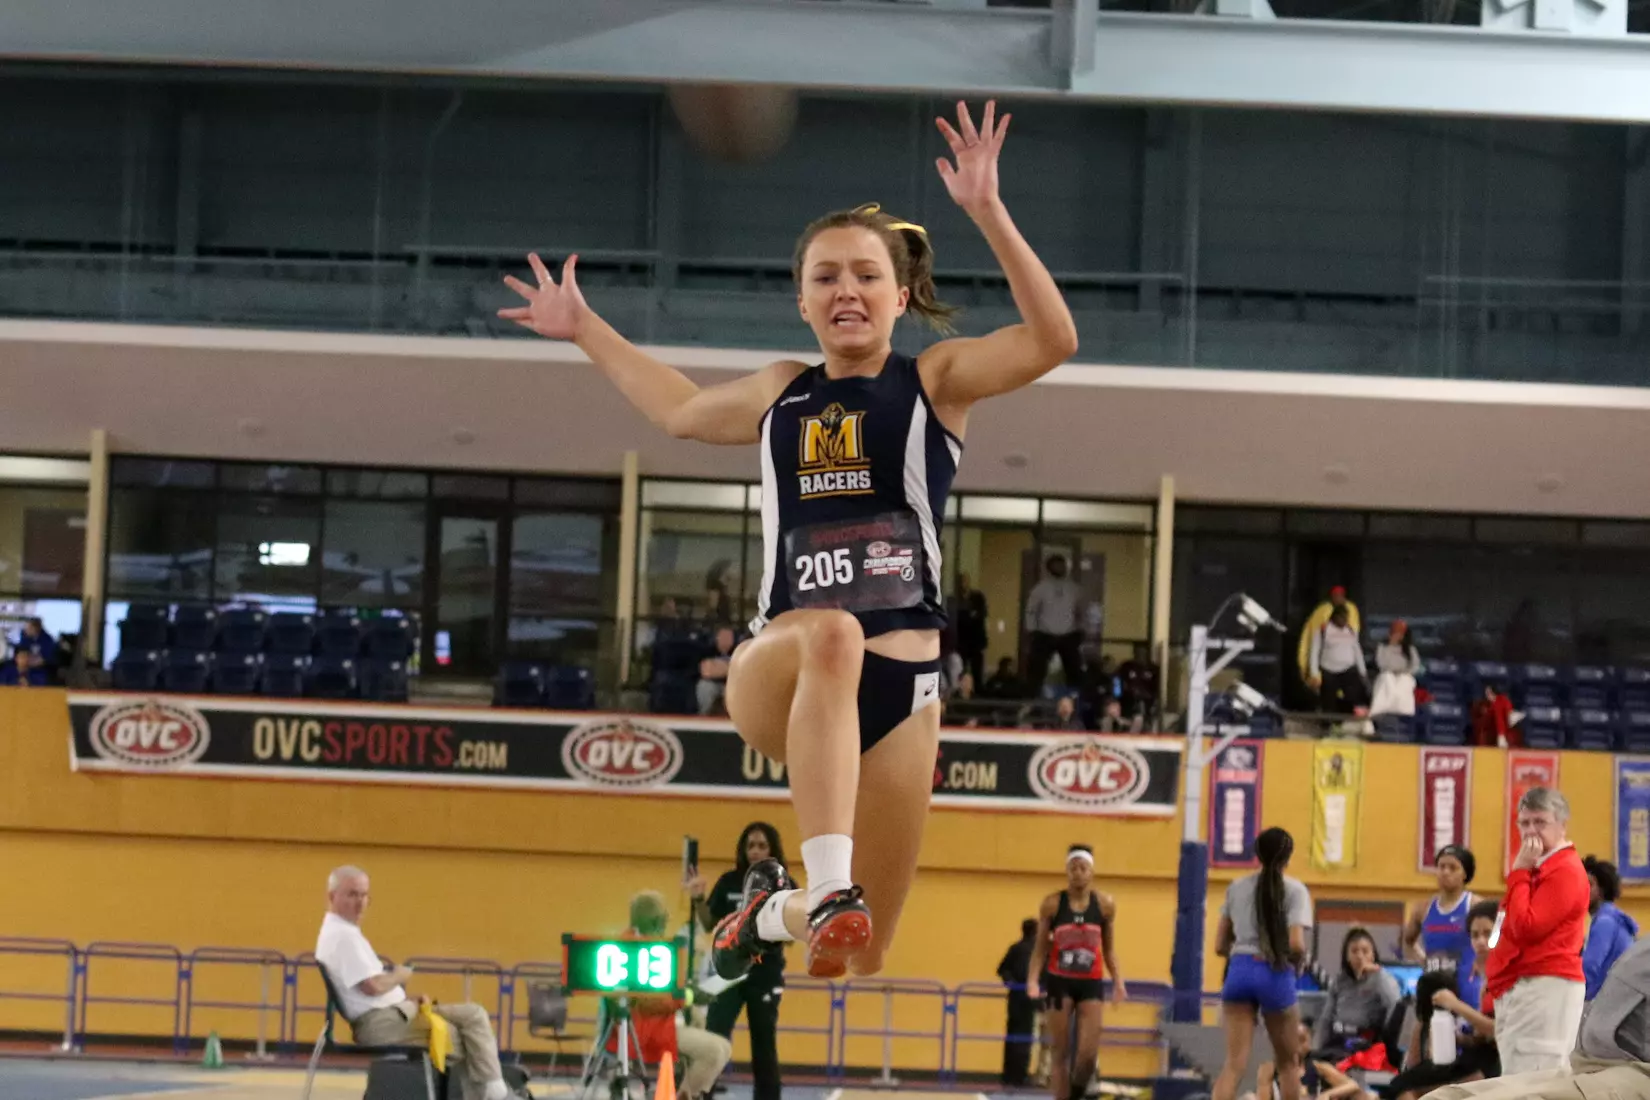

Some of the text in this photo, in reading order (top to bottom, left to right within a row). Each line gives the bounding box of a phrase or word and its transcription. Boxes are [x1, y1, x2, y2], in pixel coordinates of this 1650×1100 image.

[800, 469, 872, 495] RACERS
[795, 547, 854, 592] 205
[115, 718, 182, 750] OVC
[252, 717, 508, 769] OVCSPORTS.COM
[586, 739, 654, 772] OVC
[1054, 759, 1122, 791] OVC
[596, 943, 672, 989] 0:13
